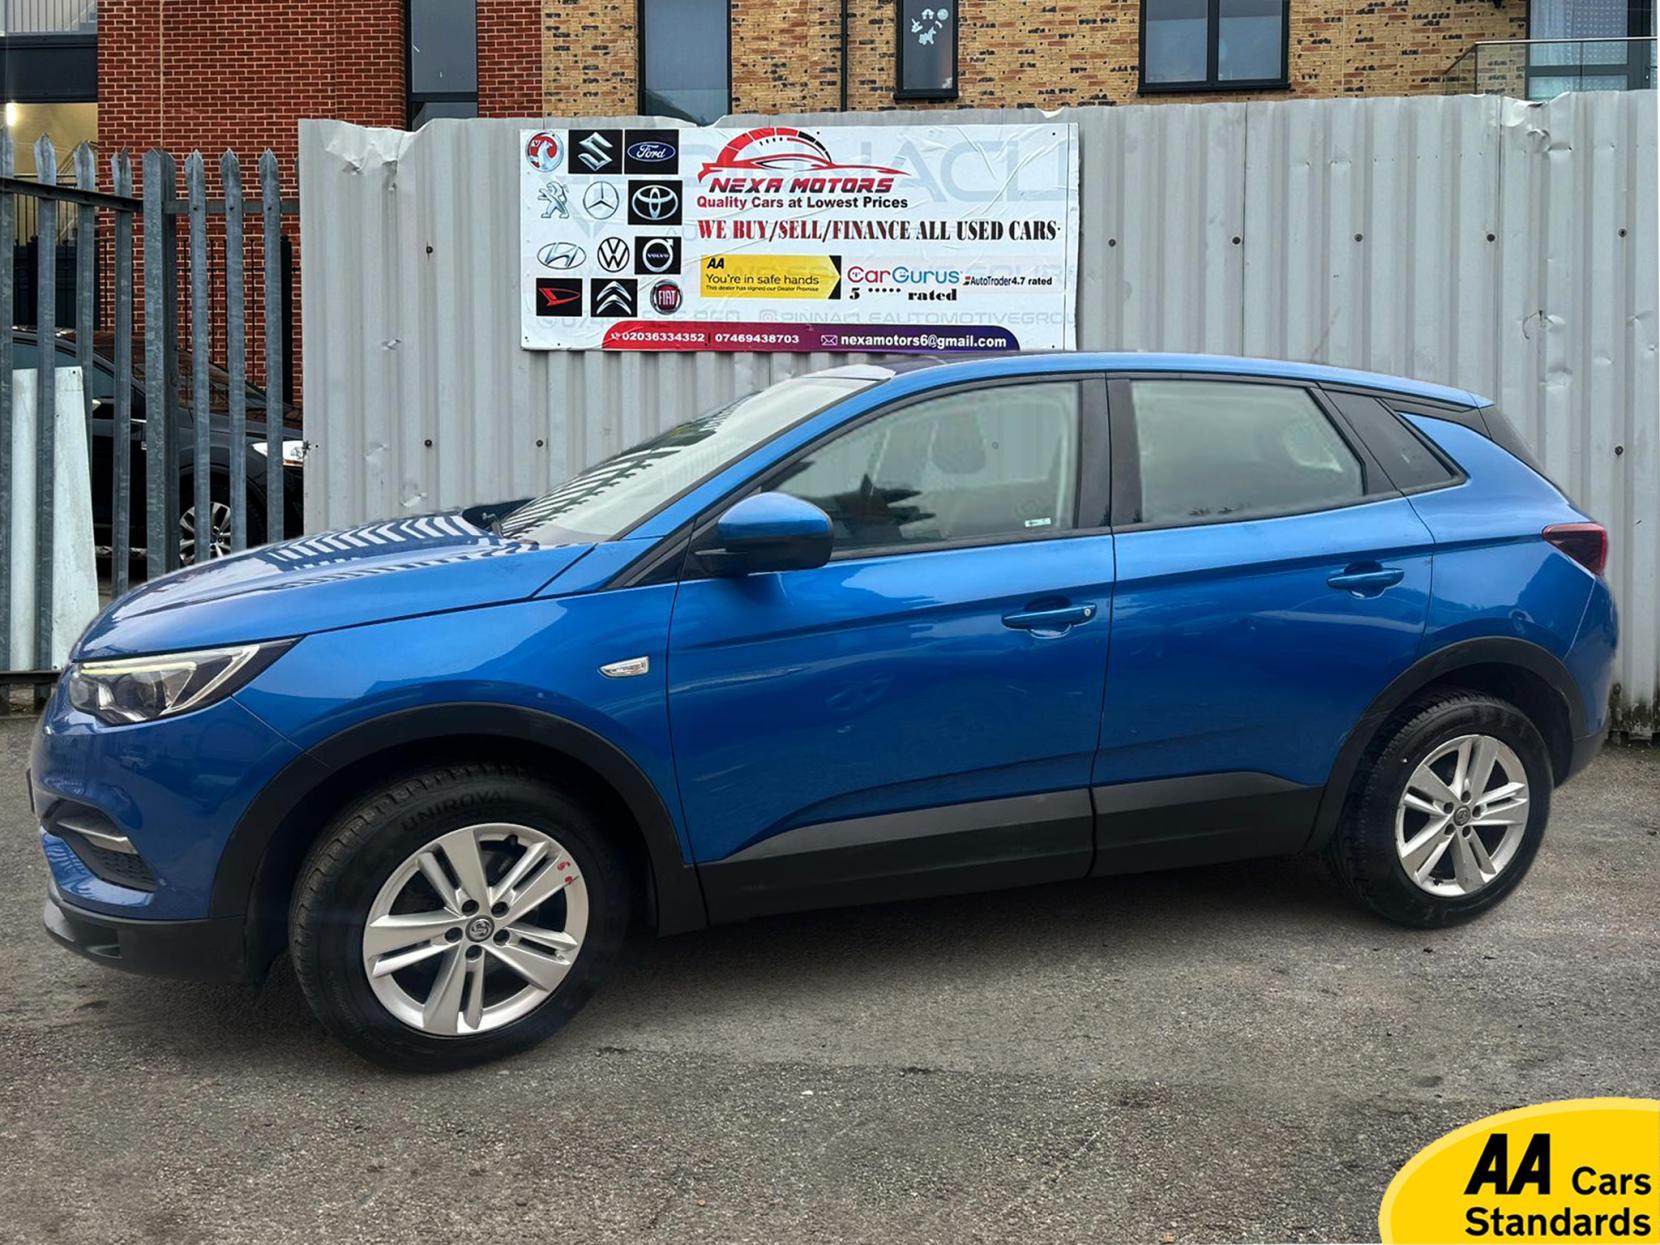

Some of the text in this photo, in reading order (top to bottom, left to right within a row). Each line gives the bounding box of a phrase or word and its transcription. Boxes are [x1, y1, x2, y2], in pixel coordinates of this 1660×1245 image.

[636, 144, 667, 159] Ford
[709, 177, 894, 194] NEXA MOTORS
[696, 195, 909, 211] Quality Cars at Lowest Prices
[697, 219, 727, 240] WE
[915, 220, 951, 241] ALL
[956, 220, 1004, 241] USED
[1008, 220, 1058, 241] CARS
[706, 257, 725, 269] AA
[705, 273, 820, 286] You're in safe hands
[847, 265, 960, 285] CarGurus
[1028, 276, 1053, 286] rated
[658, 290, 676, 306] FIAT
[849, 286, 958, 301] 5 rated
[621, 332, 800, 344] 02036334352 07469438703
[840, 333, 1007, 350] nexamotors6@gmail.com
